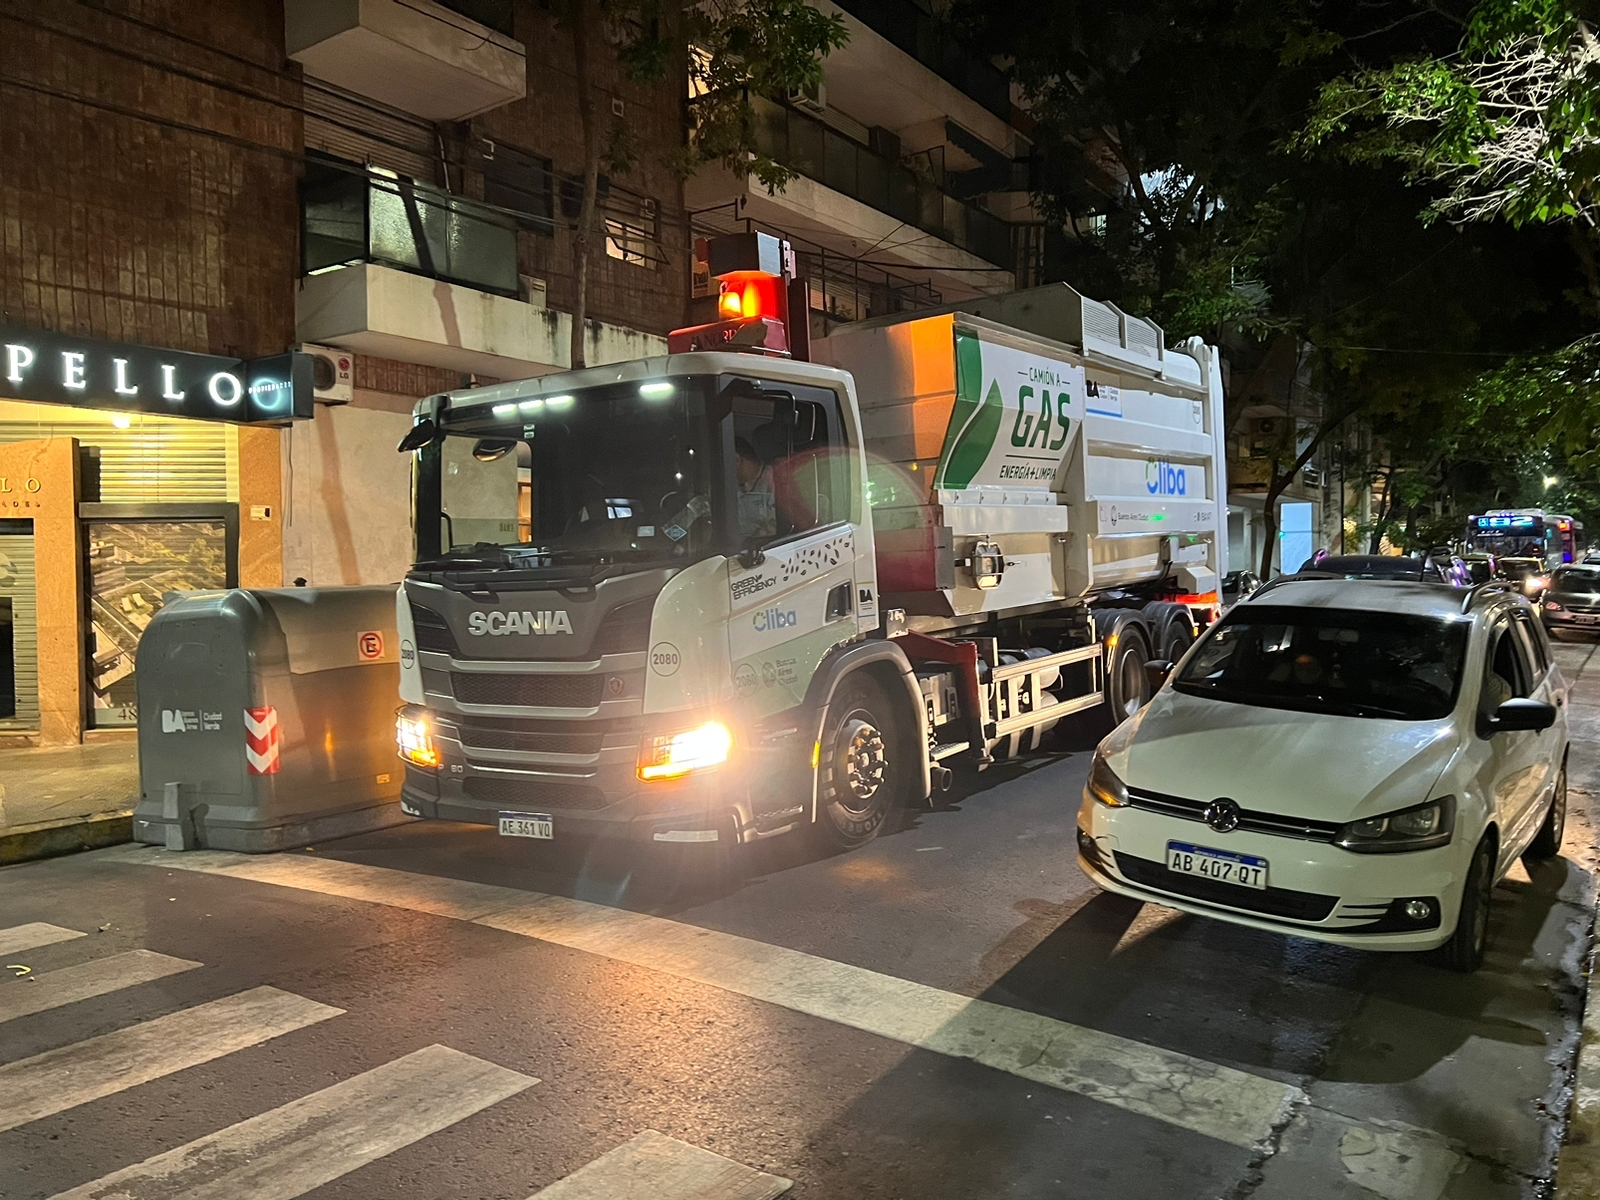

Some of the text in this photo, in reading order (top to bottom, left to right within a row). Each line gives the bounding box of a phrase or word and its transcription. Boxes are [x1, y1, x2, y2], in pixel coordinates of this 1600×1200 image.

[5, 343, 242, 406] PELLO
[339, 372, 350, 380] LG
[1029, 367, 1061, 387] CAMIÓN A
[1011, 385, 1071, 451] GAS
[1145, 458, 1186, 496] Cliba
[1489, 516, 1534, 527] 92
[731, 575, 758, 591] GREEN
[733, 576, 777, 600] EFFICIENCY
[468, 610, 574, 636] SCANIA
[753, 608, 797, 632] Cliba
[653, 653, 678, 666] 2080
[502, 820, 515, 834] AE
[517, 821, 535, 835] 361
[1172, 852, 1262, 885] AB 407 QT
